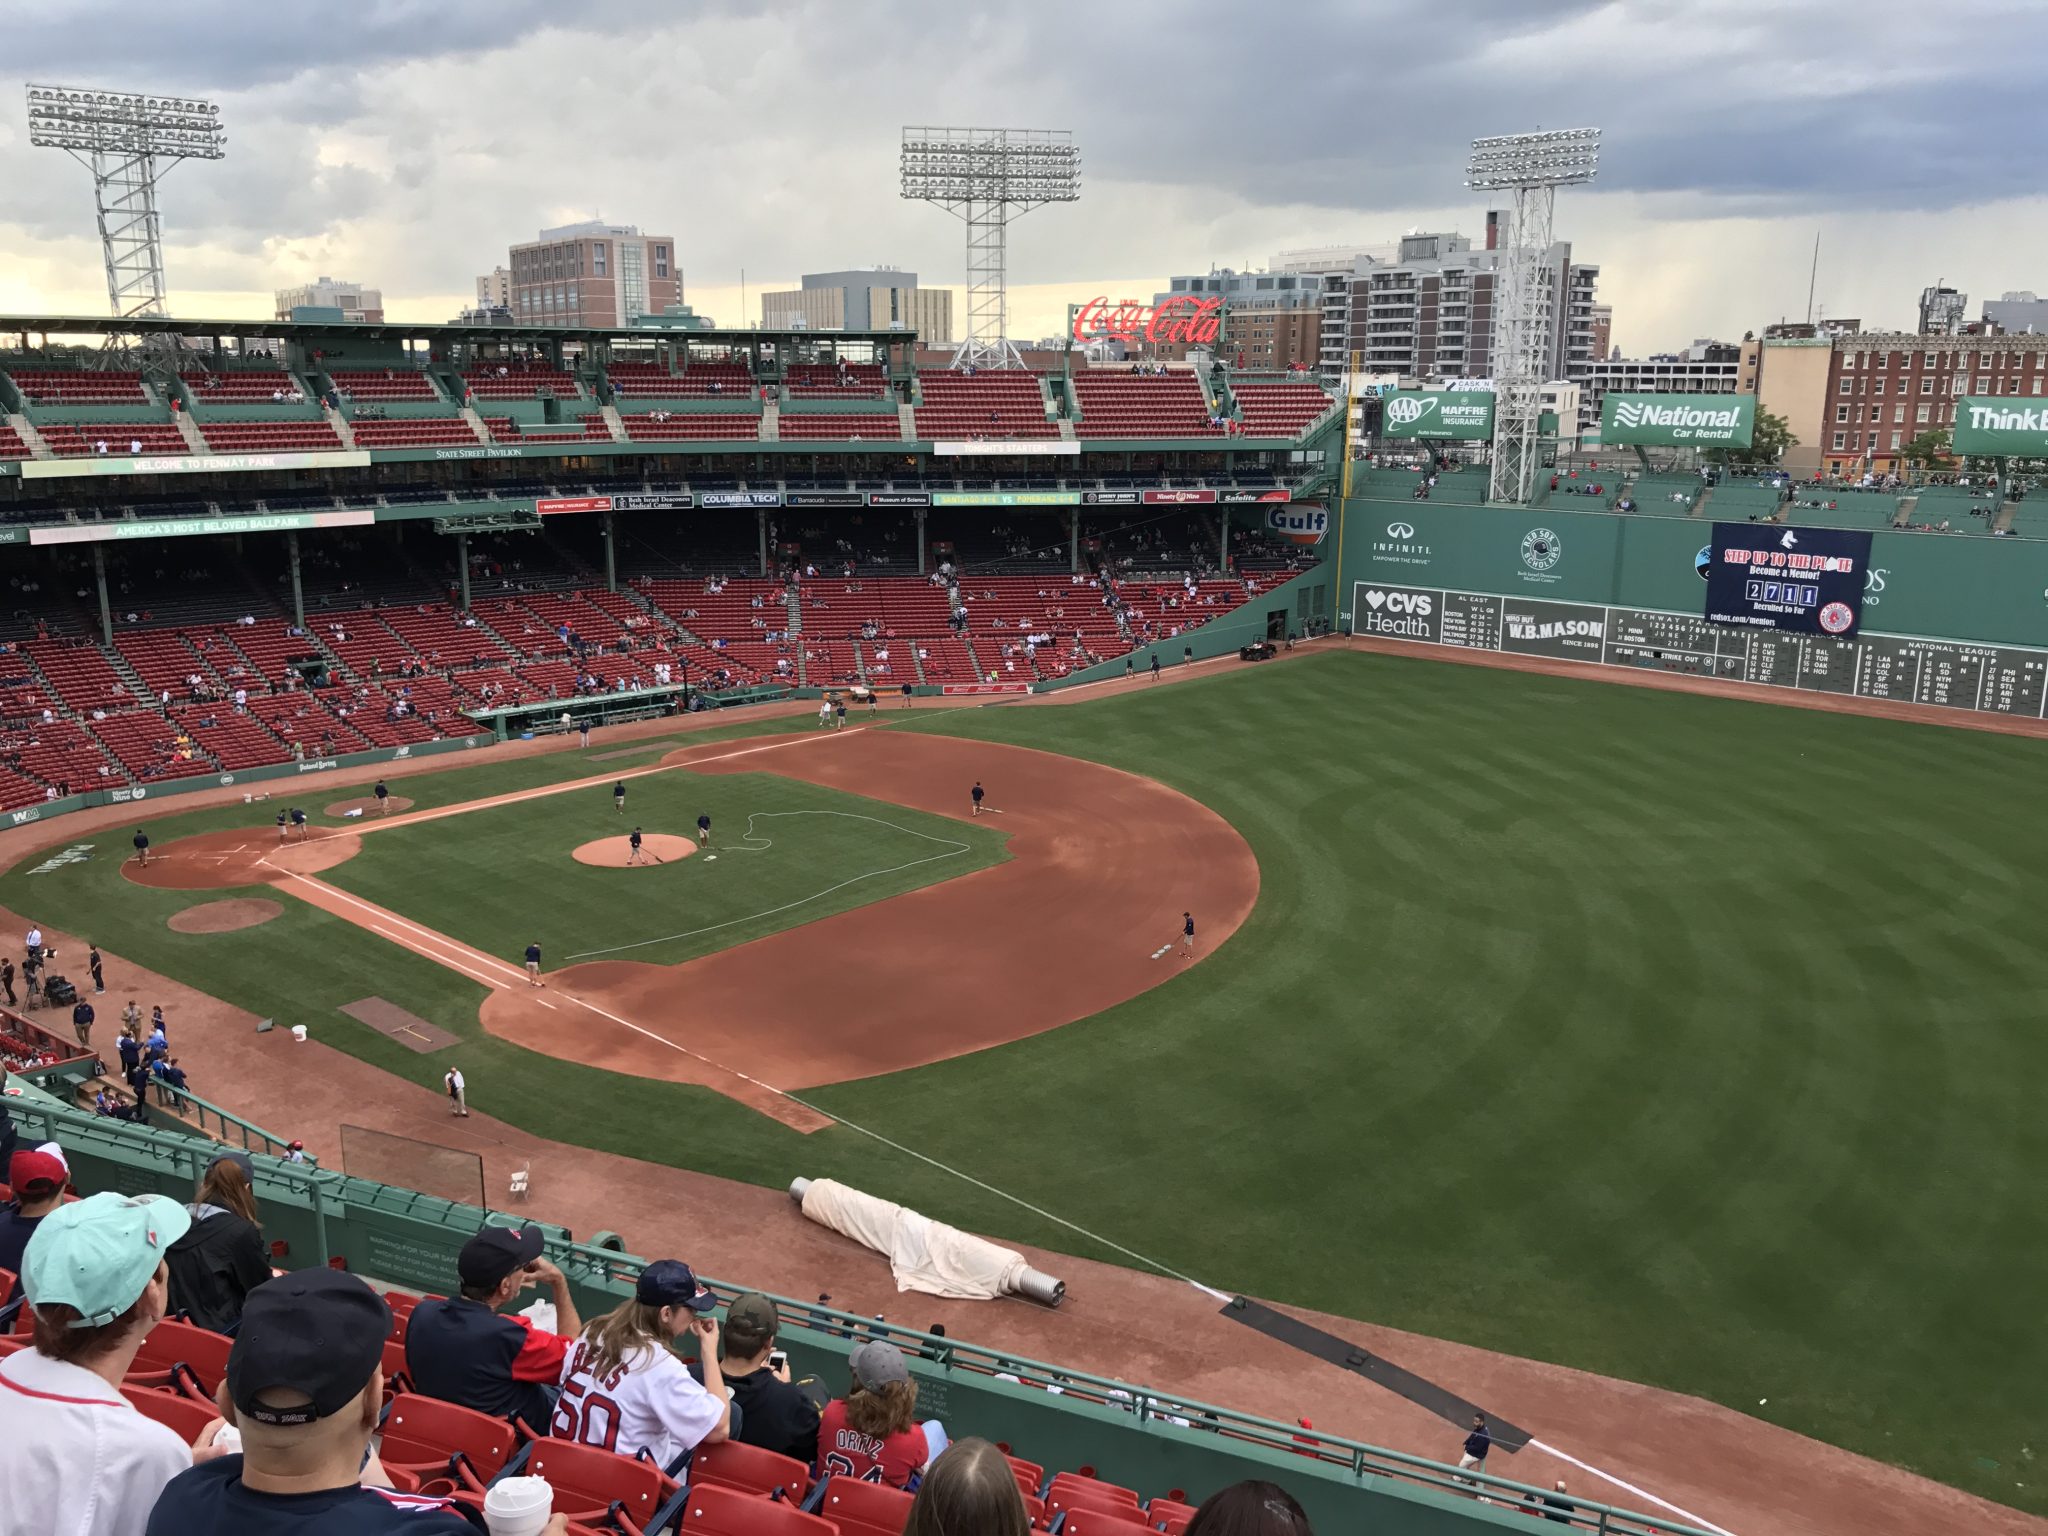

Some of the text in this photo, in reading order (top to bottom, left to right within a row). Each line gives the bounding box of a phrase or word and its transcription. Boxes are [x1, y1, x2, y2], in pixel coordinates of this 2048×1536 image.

[1074, 296, 1227, 343] Coca-Cola
[1392, 399, 1418, 421] AAA
[1441, 406, 1488, 415] MAPFRE
[1442, 417, 1484, 426] INSURANCE
[1672, 428, 1733, 439] Car Rental
[436, 448, 521, 459] STATE STREET PAVILION
[963, 444, 1048, 452] TONIGHT'S STARTERS
[133, 457, 275, 470] WELCOME TO FENWAY PARK
[703, 495, 751, 504] COLUMBIA
[753, 495, 777, 503] TECH
[1002, 495, 1012, 504] VS
[1157, 493, 1176, 501] Ninety
[1224, 494, 1257, 502] Safelite
[1270, 508, 1325, 531] Gulf
[116, 517, 300, 536] AMERICA'S MOST BELOVED BALLPARK
[1523, 530, 1554, 547] RED SOX
[1373, 555, 1400, 563] EMPOWER
[1524, 546, 1559, 568] SCHOLARS
[1725, 549, 1853, 573] STEP UP TO THE PLTE
[1750, 565, 1820, 580] Become a Mentor!
[1386, 592, 1432, 616] CVS
[1753, 602, 1805, 615] Recruited So Far
[1340, 612, 1351, 620] 310
[1634, 613, 1680, 623] FENWAY
[1710, 612, 1776, 627] redsox.com/mentors
[1366, 611, 1430, 637] Health
[1443, 631, 1467, 639] BALTIMORE
[1628, 627, 1679, 639] MINN JUNE
[1443, 638, 1465, 646] TORONTO
[1583, 641, 1599, 649] 1898
[1624, 635, 1693, 648] BOSTON 2017
[1639, 650, 1654, 658] BALL
[1661, 653, 1682, 661] STRIKE
[1908, 642, 1997, 657] NATIONAL LEAGUE
[2001, 675, 2015, 683] SEA
[1998, 703, 2011, 711] PIT
[299, 760, 337, 773] Poland Spring
[402, 1244, 418, 1254] FOR
[419, 1249, 440, 1259] YOUR
[369, 1258, 393, 1268] PLEASE
[393, 1264, 403, 1272] DO
[403, 1267, 416, 1275] NOT
[416, 1270, 438, 1281] REACH
[933, 1384, 948, 1392] FOR
[932, 1399, 947, 1407] NOT
[552, 1378, 622, 1452] 50
[836, 1428, 884, 1460] ORTIZ
